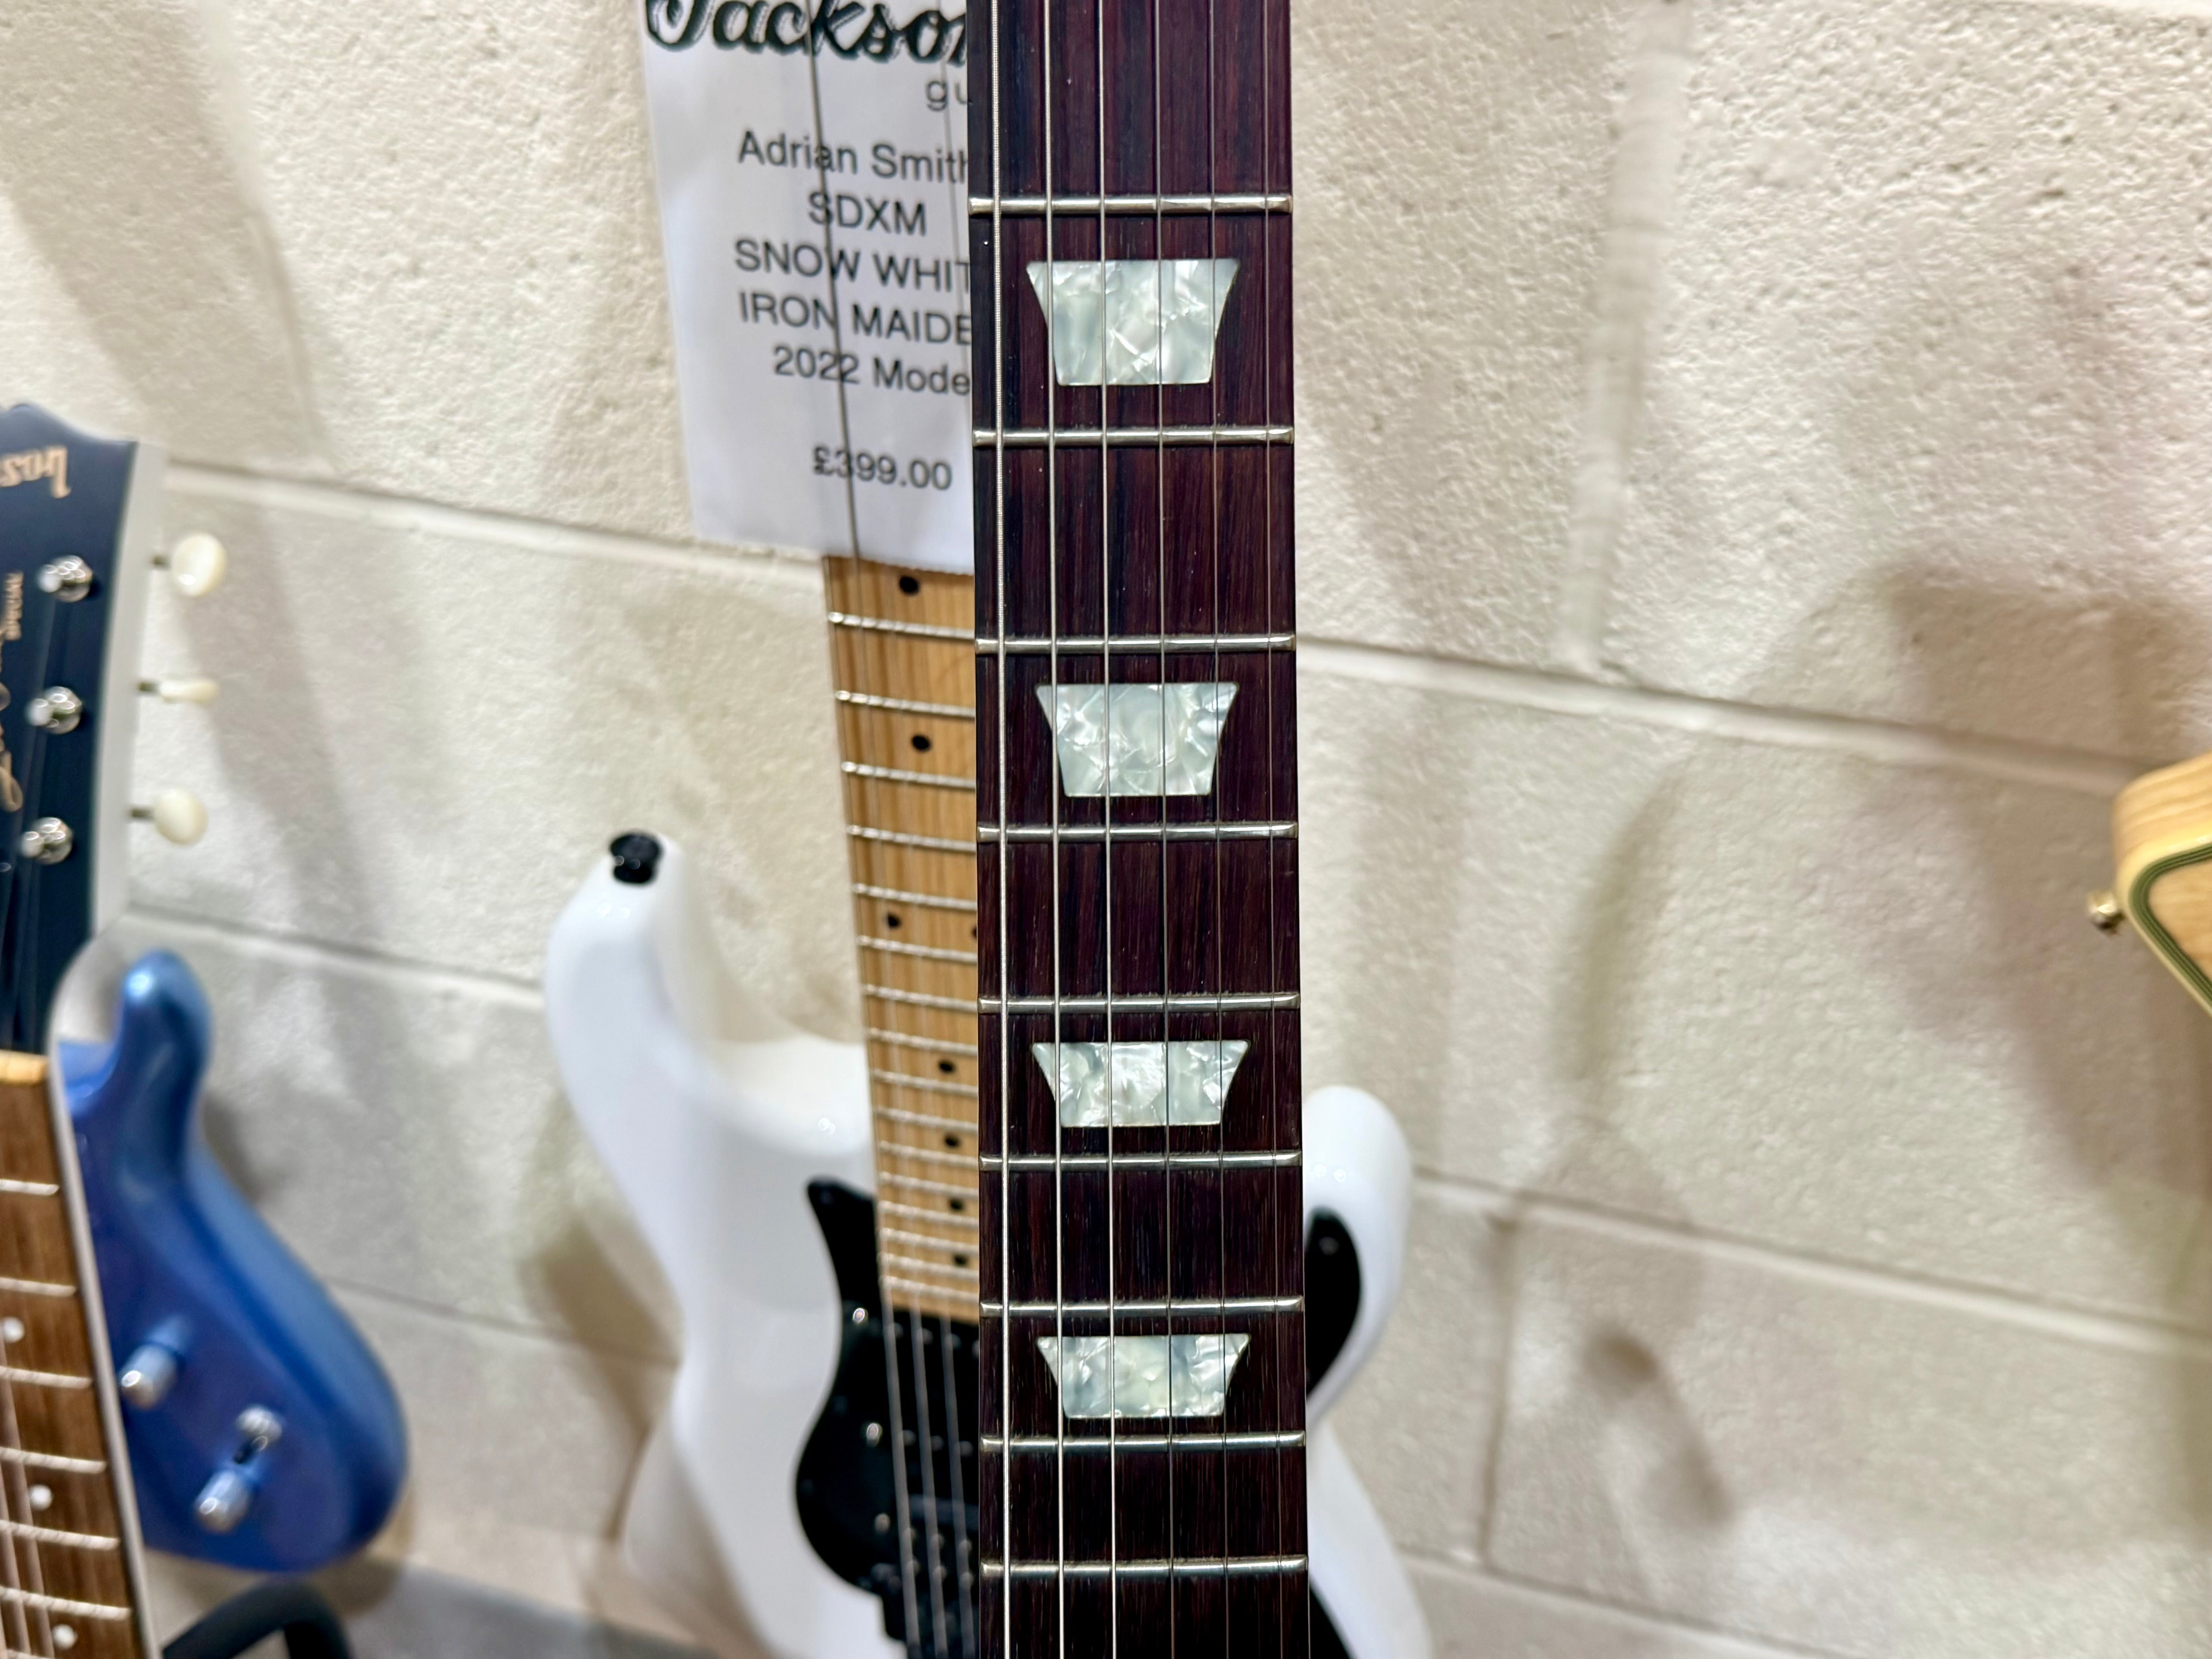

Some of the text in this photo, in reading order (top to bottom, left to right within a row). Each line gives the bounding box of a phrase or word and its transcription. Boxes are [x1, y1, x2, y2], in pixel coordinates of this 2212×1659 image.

[738, 130, 857, 174] Adrian
[809, 192, 927, 236] SDXM
[735, 239, 970, 293] SNOW WHIT
[739, 291, 971, 345] IRON MAIDE
[774, 345, 970, 396] 2022 Mode
[813, 445, 953, 491] £399.00
